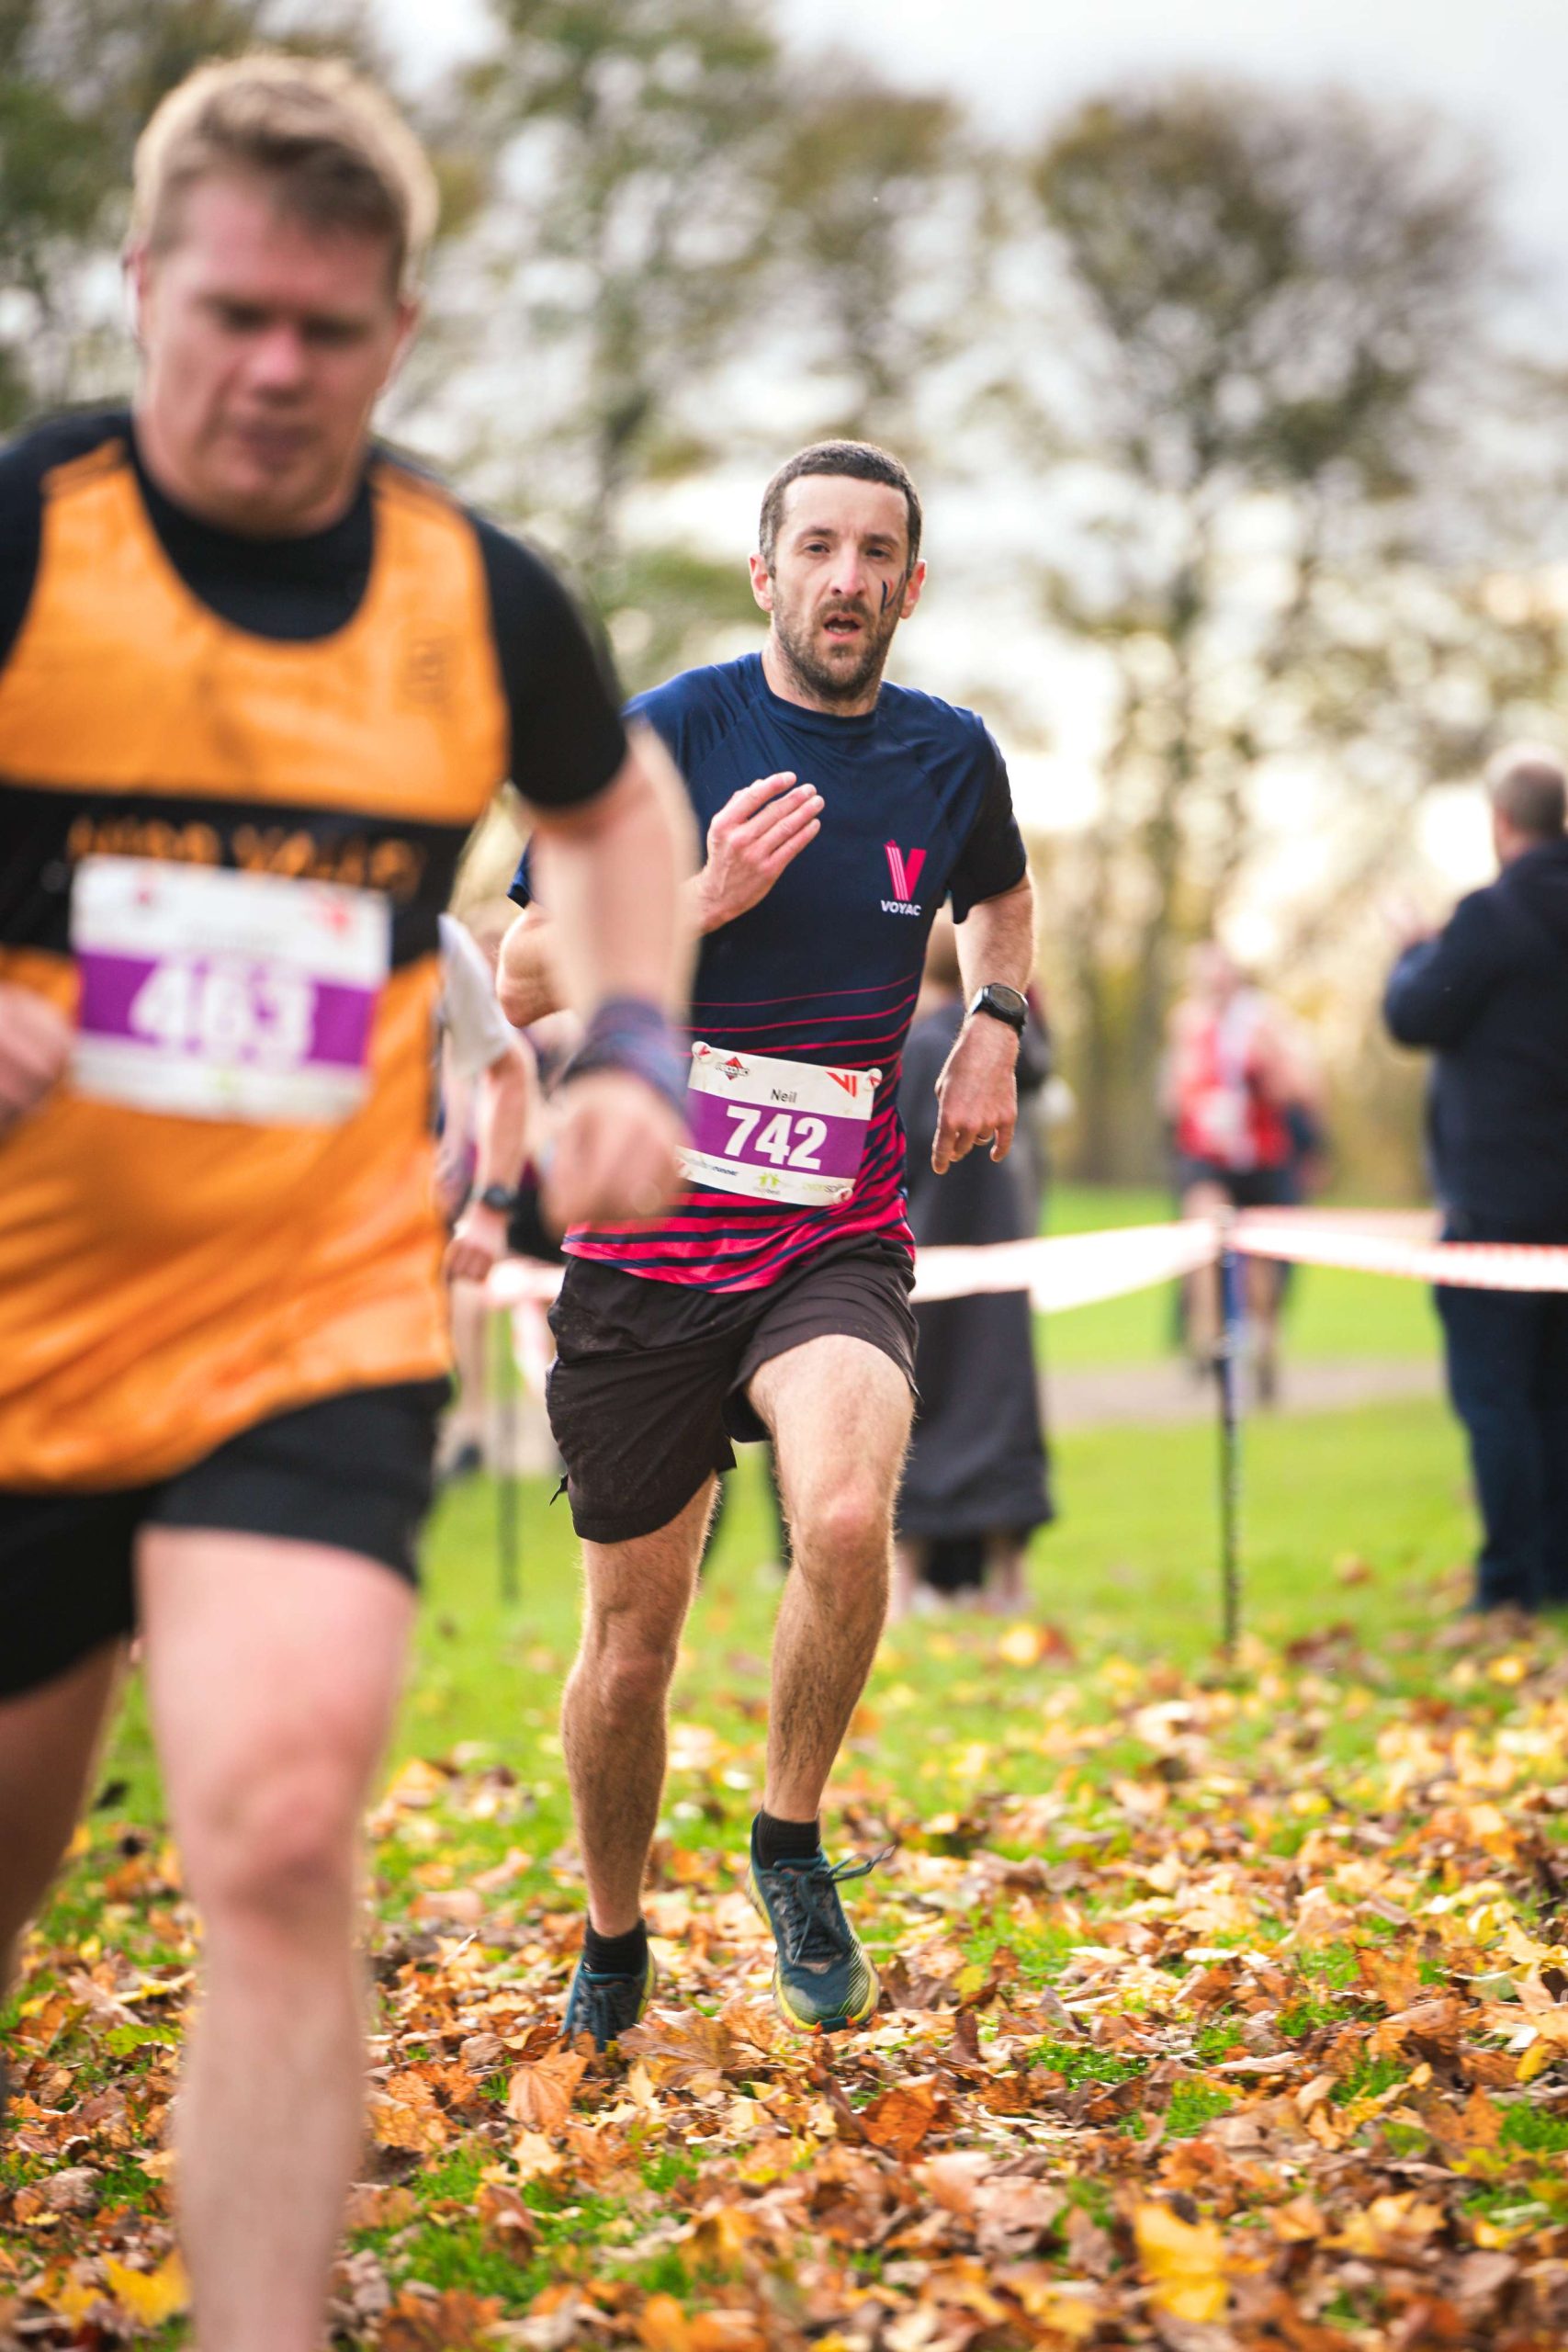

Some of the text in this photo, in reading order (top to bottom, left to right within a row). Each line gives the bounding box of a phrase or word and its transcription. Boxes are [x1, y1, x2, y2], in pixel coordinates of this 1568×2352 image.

[880, 899, 922, 916] VOYAC
[127, 952, 314, 1068] 463
[771, 1088, 797, 1103] Neil
[724, 1104, 828, 1170] 742
